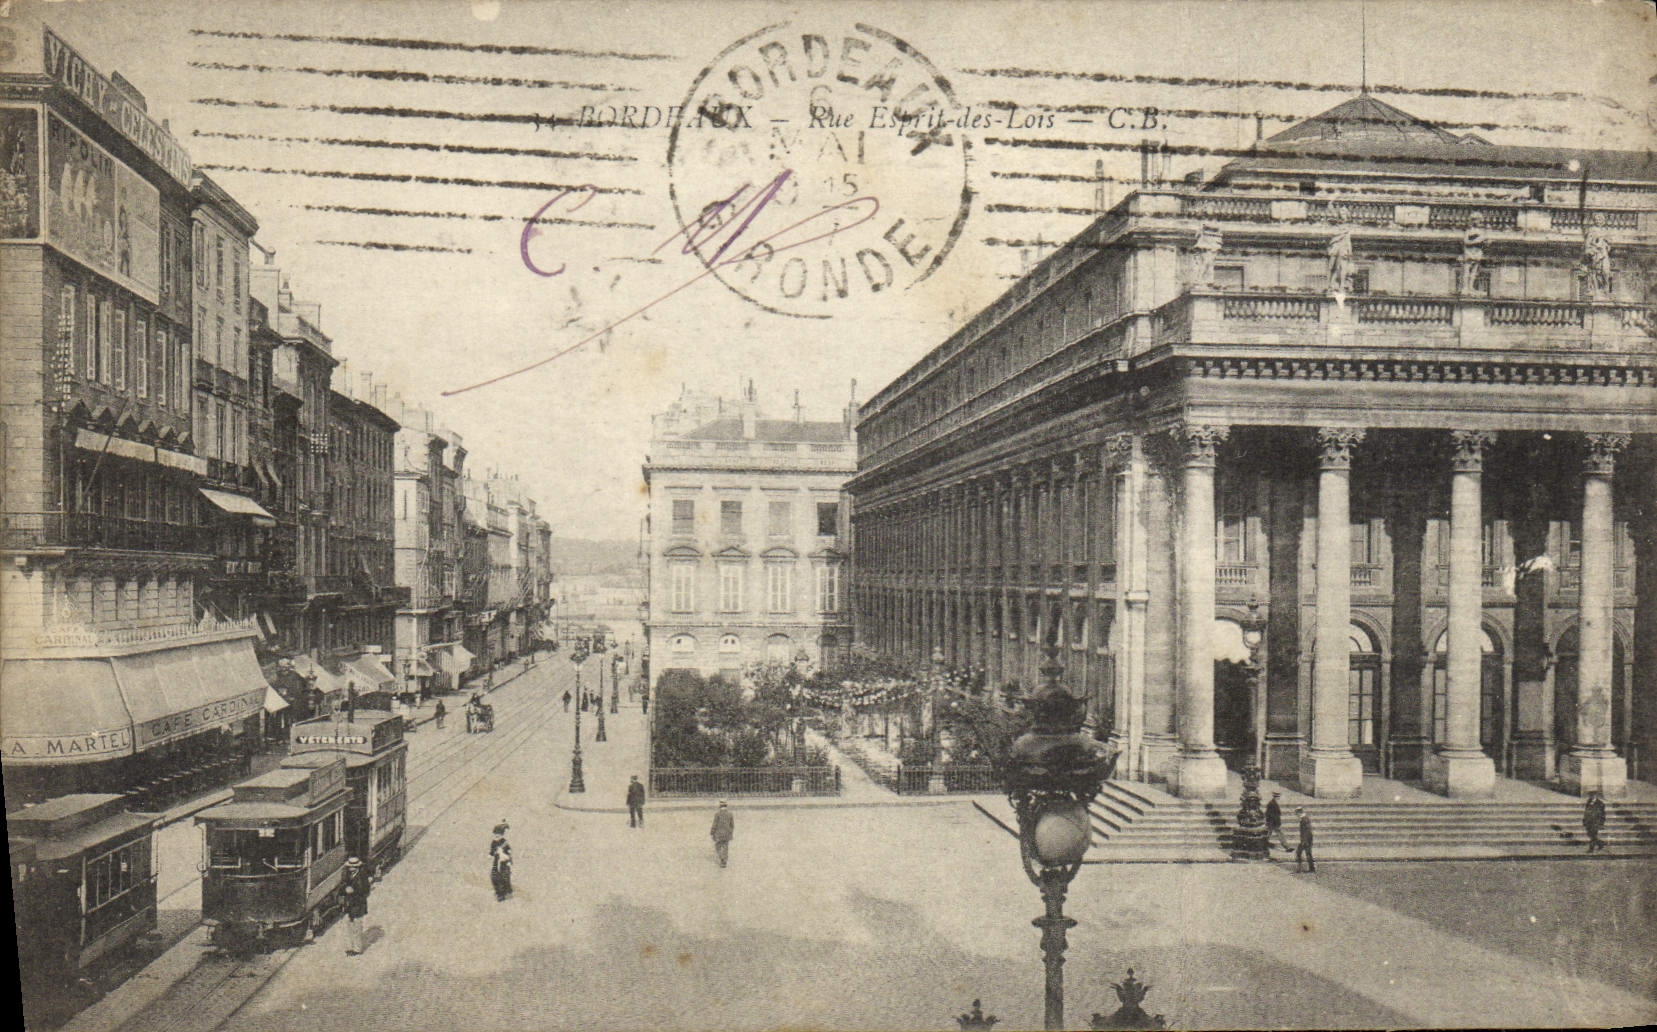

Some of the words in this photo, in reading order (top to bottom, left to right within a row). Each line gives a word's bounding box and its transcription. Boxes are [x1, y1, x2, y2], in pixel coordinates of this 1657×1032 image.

[48, 34, 108, 114] VICHY
[151, 713, 192, 736] CAFE
[47, 732, 129, 755] MARTEL
